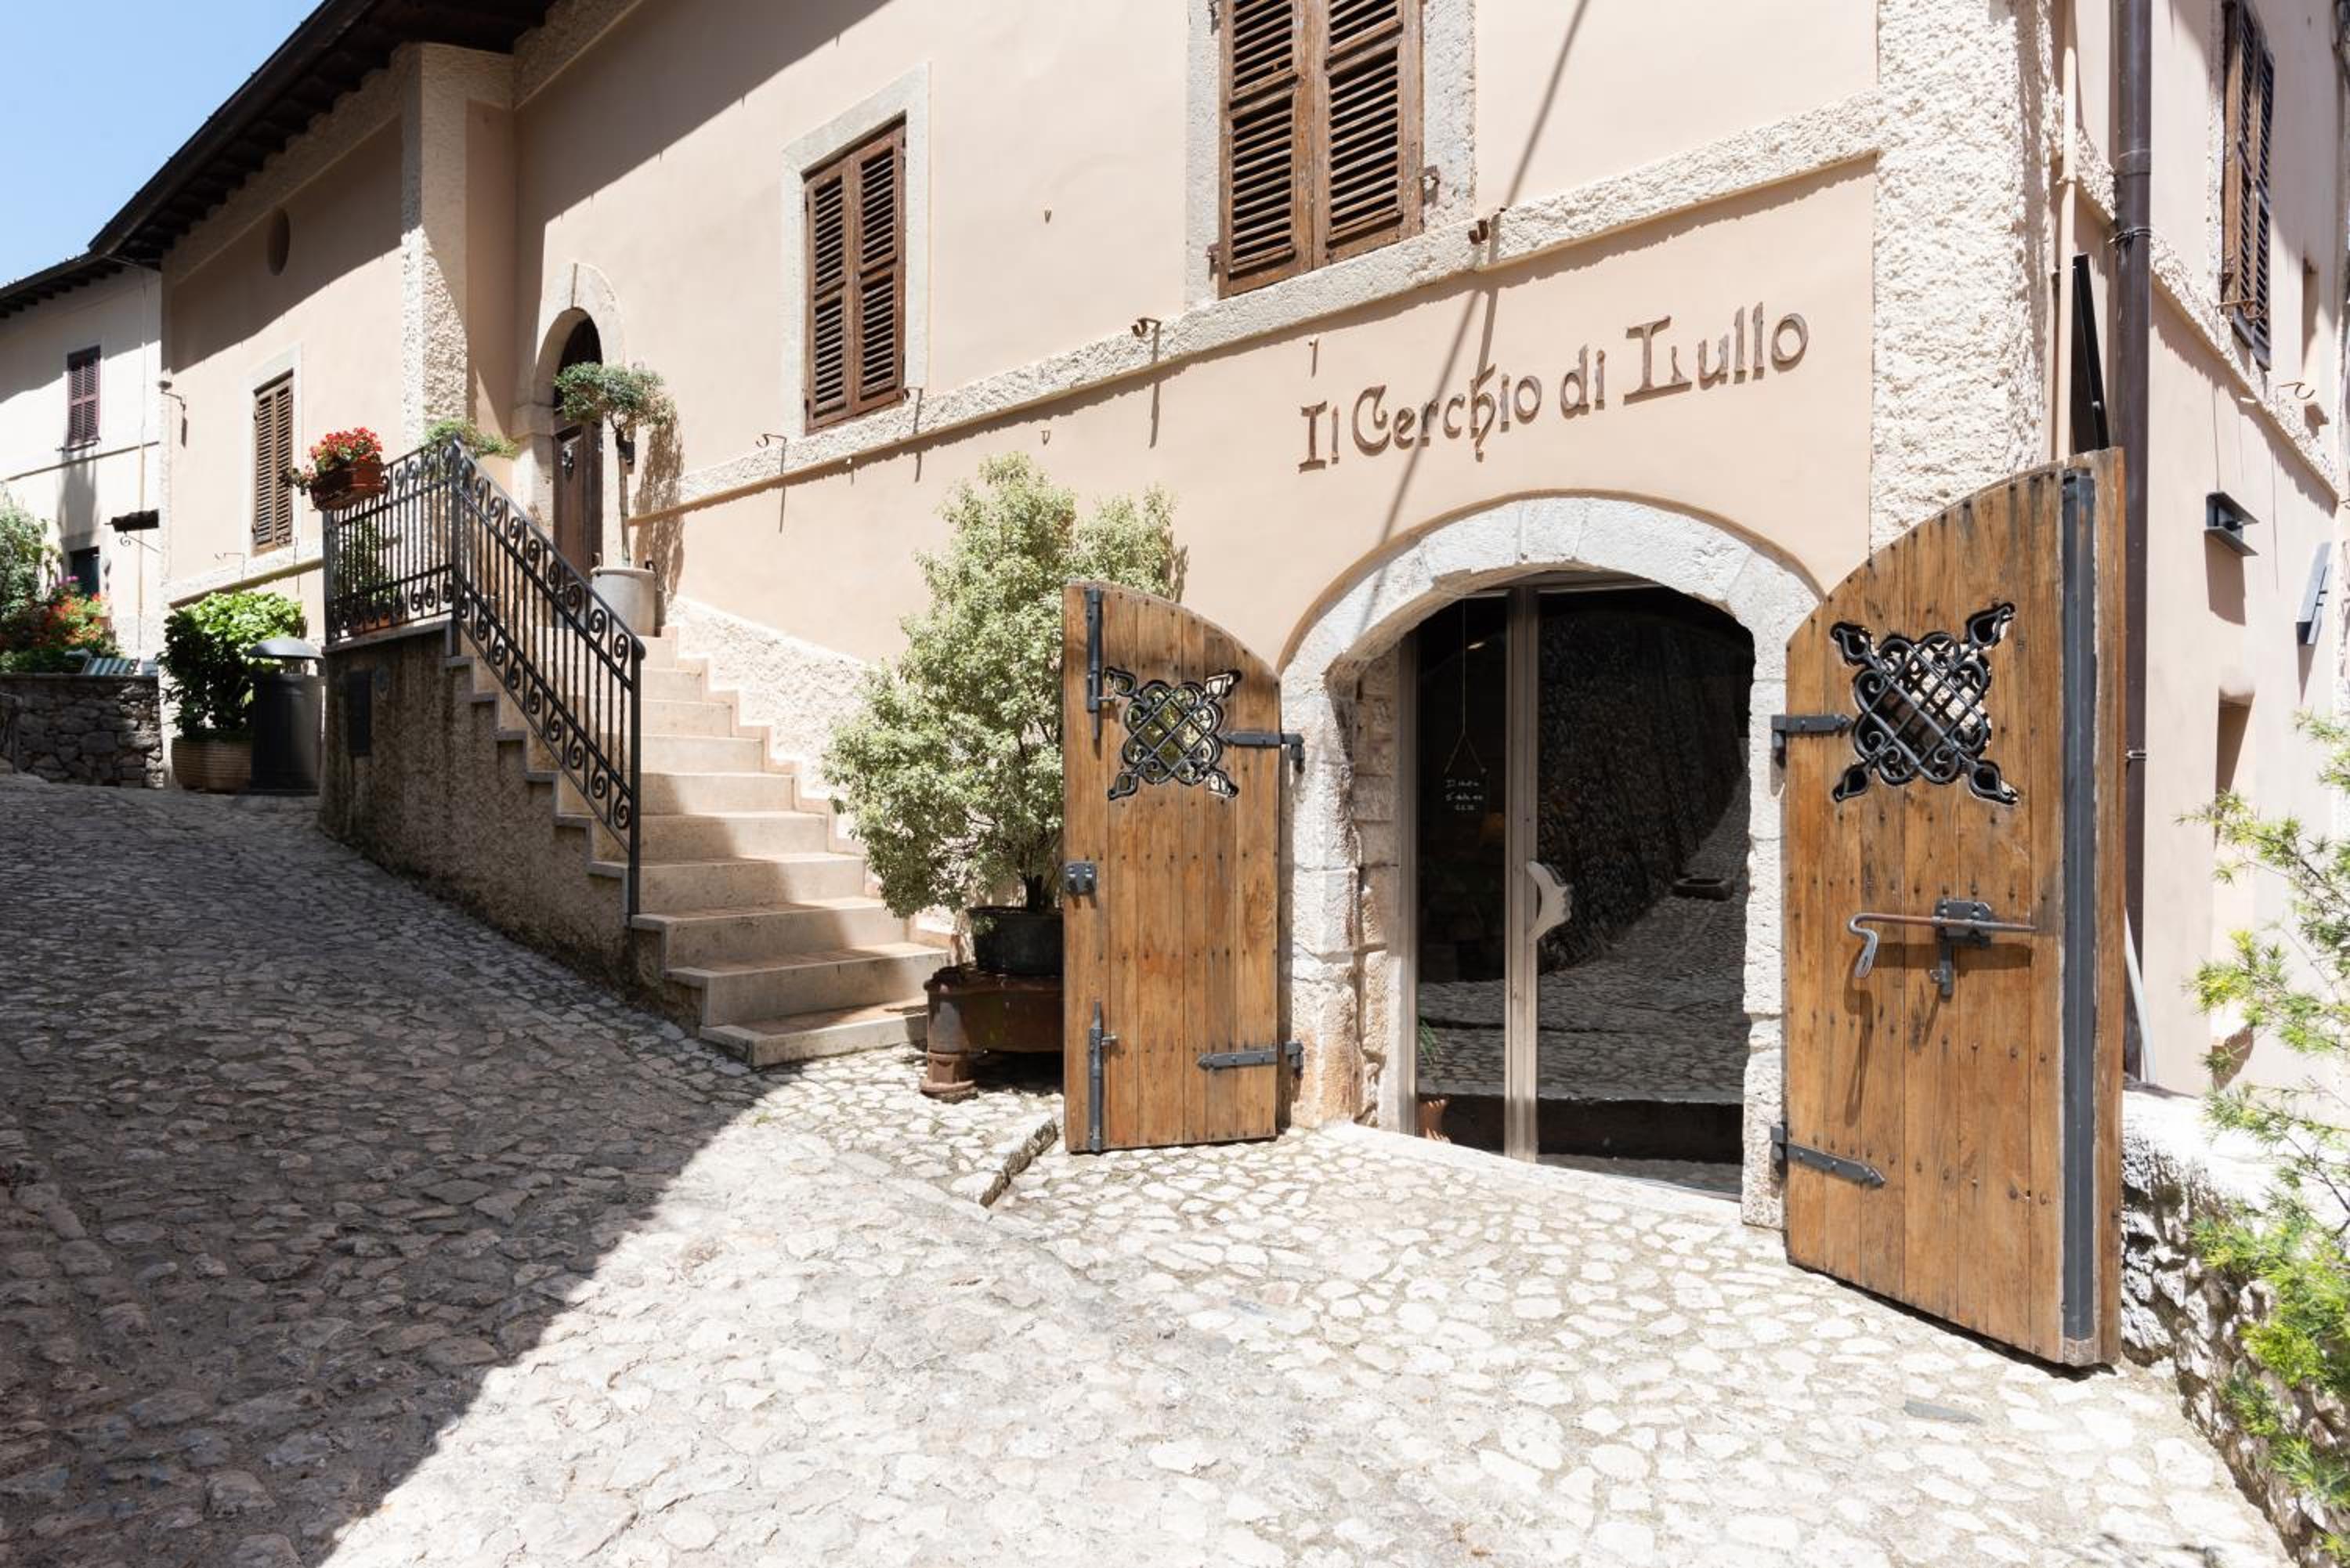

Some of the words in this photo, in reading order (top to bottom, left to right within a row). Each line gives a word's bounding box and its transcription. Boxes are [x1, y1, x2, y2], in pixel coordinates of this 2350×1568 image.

[1298, 400, 1340, 473] Il
[1351, 363, 1542, 461] Cerchio
[1560, 344, 1606, 418] di
[1623, 302, 1810, 405] Lullo
